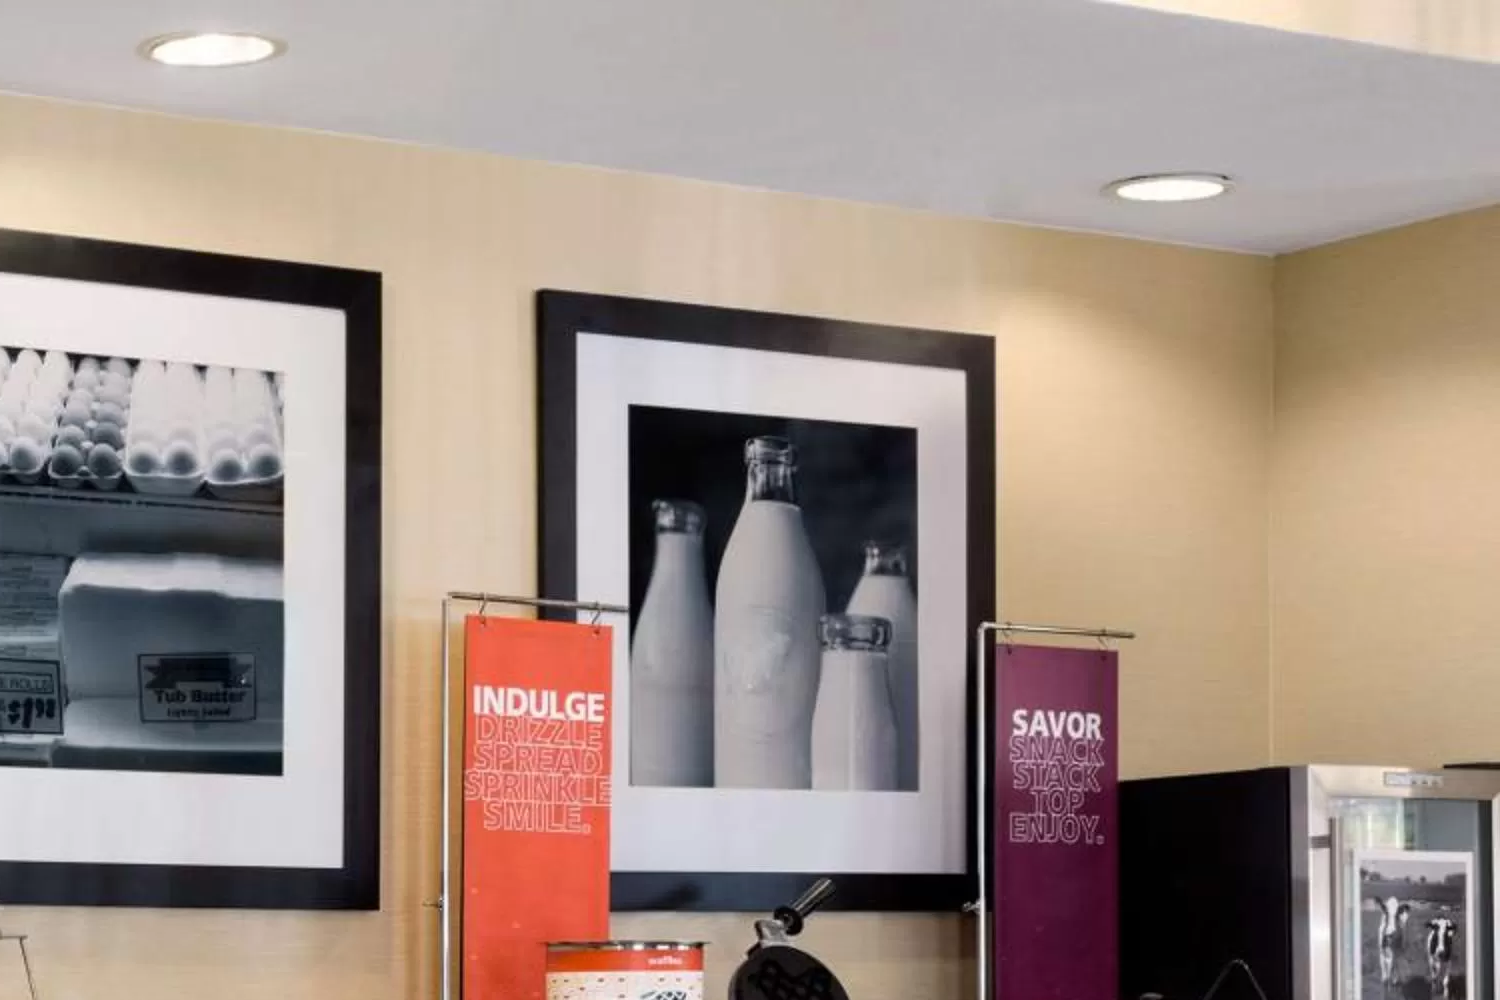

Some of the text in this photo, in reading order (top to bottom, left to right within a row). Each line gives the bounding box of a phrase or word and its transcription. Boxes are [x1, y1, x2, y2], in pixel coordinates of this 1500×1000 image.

[153, 689, 247, 704] Tub Butter
[472, 685, 605, 723] INDULGE
[475, 716, 604, 751] DRIZZLE
[1012, 709, 1103, 740] SAVOR
[473, 741, 603, 777] SPREAD
[1009, 736, 1105, 766] SNACK
[464, 768, 612, 807] SPRINKLE
[1013, 760, 1103, 792] STACK
[483, 799, 592, 835] SMILE.
[1030, 787, 1085, 817] TOP
[1009, 812, 1105, 845] ENJOY.
